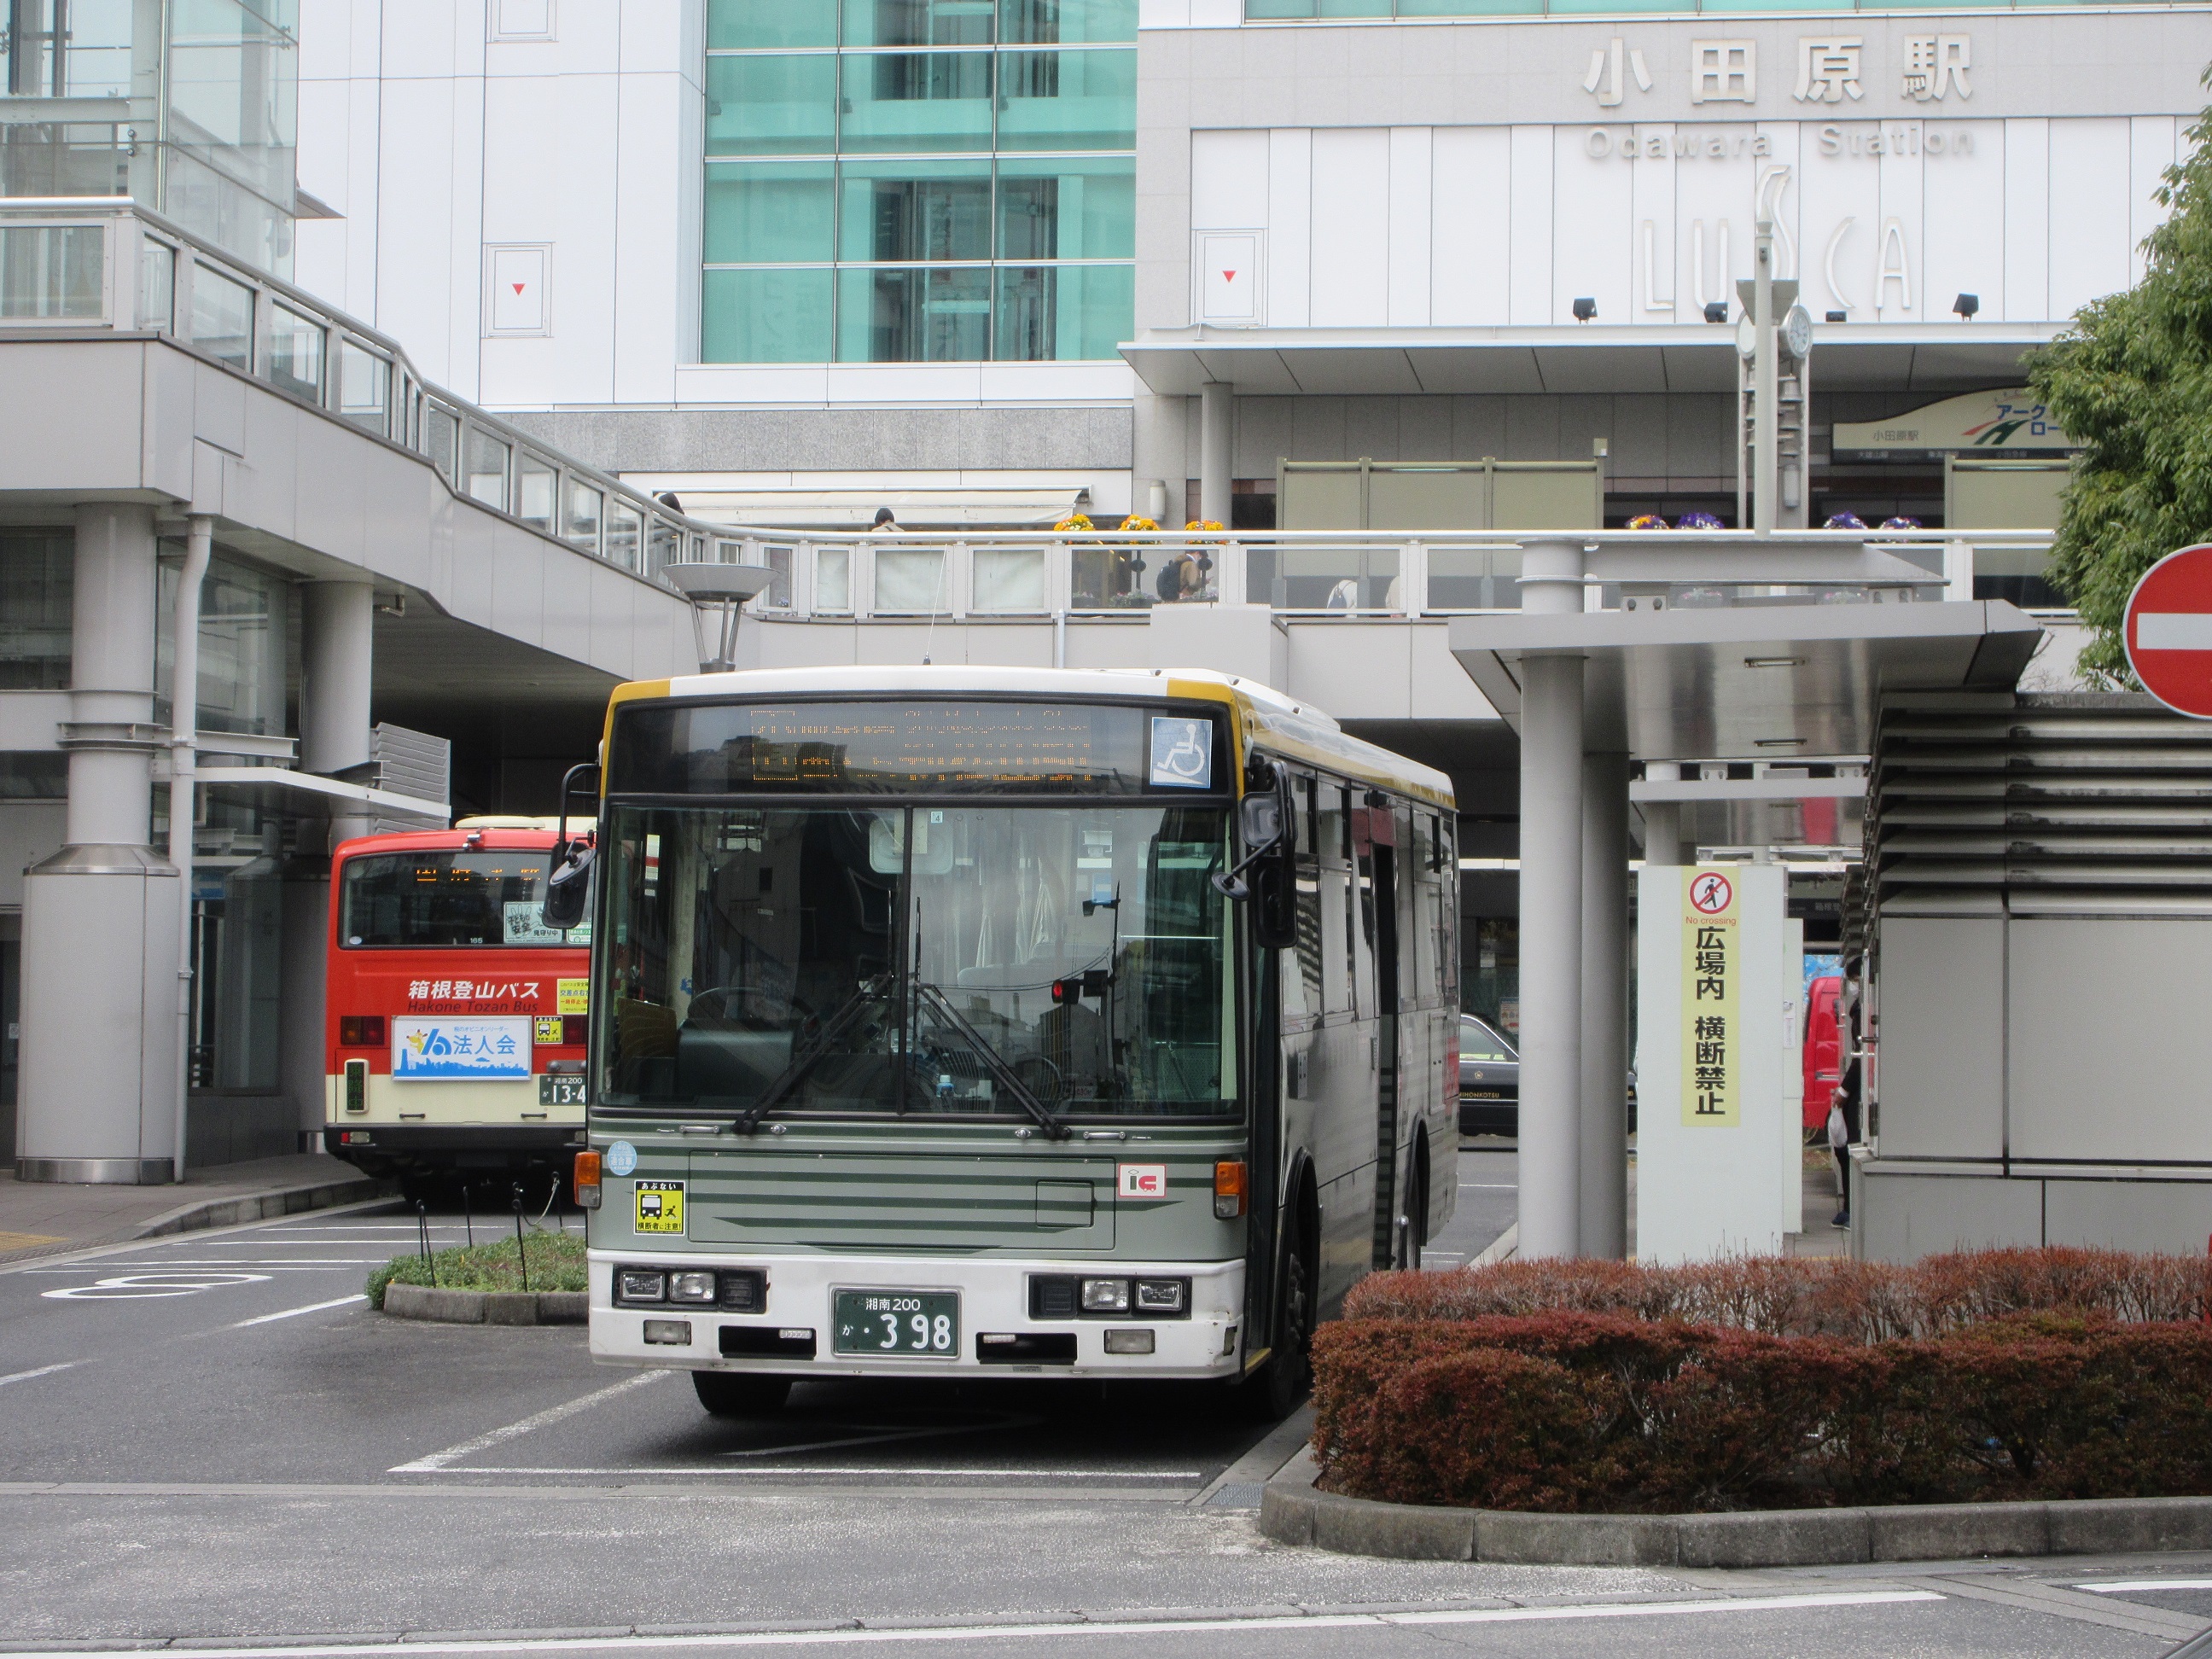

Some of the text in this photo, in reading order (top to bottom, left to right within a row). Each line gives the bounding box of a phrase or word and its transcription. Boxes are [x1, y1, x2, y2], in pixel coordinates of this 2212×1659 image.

[1583, 33, 1972, 106] 小田原駅
[1585, 124, 1976, 159] Odawara Station
[1642, 164, 1912, 311] LUSCA
[1996, 404, 2046, 420] アーク
[1873, 429, 1919, 442] 小田原駅
[2031, 421, 2061, 436] ロー
[1685, 916, 1737, 927] No crossing
[1695, 926, 1726, 1001] 広場内
[408, 981, 539, 999] 箱根登山バス
[407, 1001, 538, 1013] Hakone Tozan Bus
[453, 1034, 516, 1055] 法人会
[1695, 1016, 1726, 1116] 横断禁止
[553, 1085, 585, 1103] 13-4
[641, 1182, 677, 1190] あぶない
[842, 1324, 854, 1336] か
